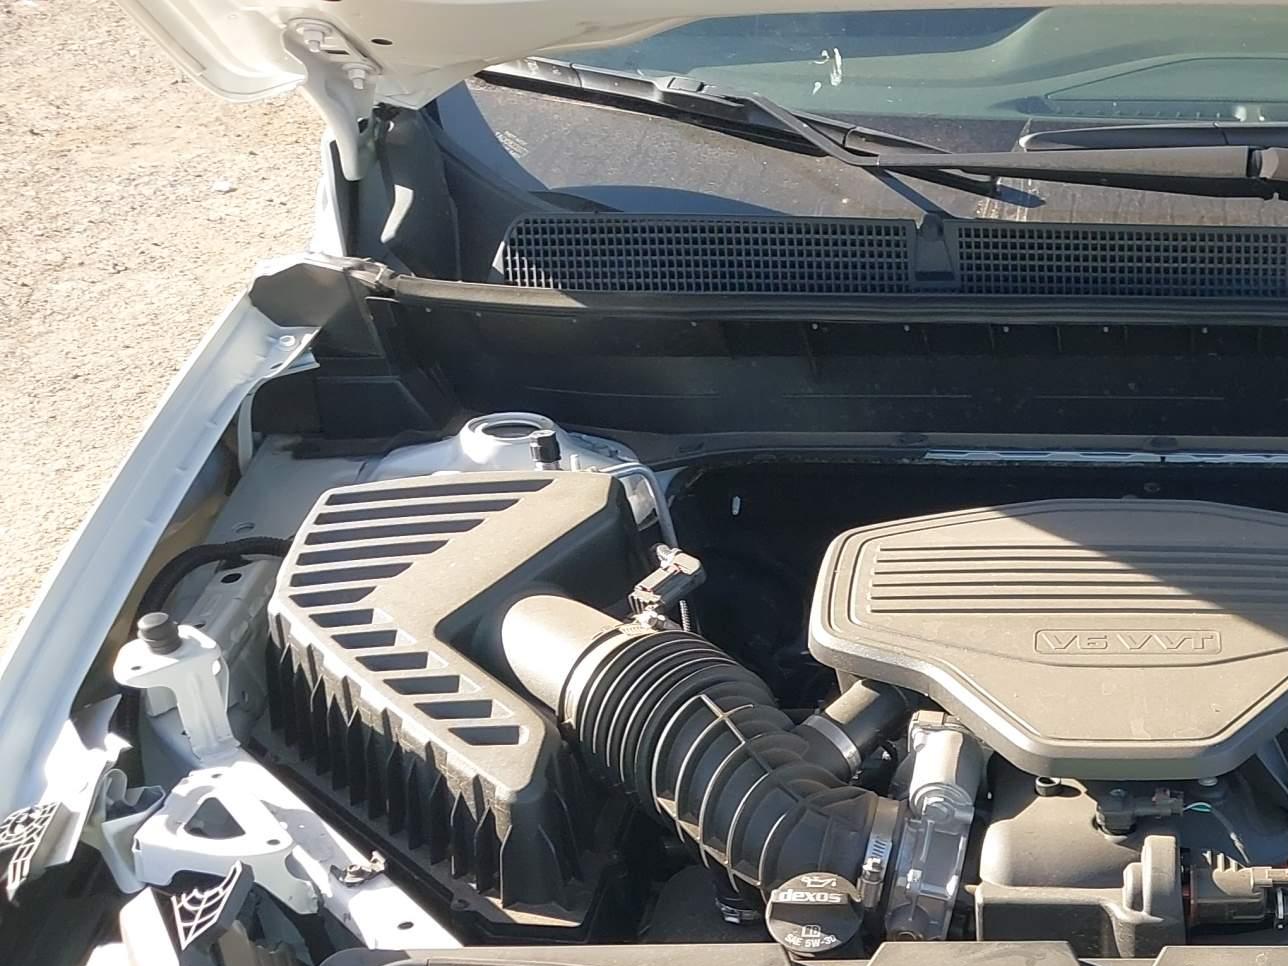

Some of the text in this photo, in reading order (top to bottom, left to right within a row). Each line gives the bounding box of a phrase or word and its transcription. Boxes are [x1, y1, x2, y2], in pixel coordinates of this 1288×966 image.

[1041, 633, 1214, 651] V6 VVT
[779, 888, 842, 903] dexos
[784, 933, 837, 948] SAE 5W-30
